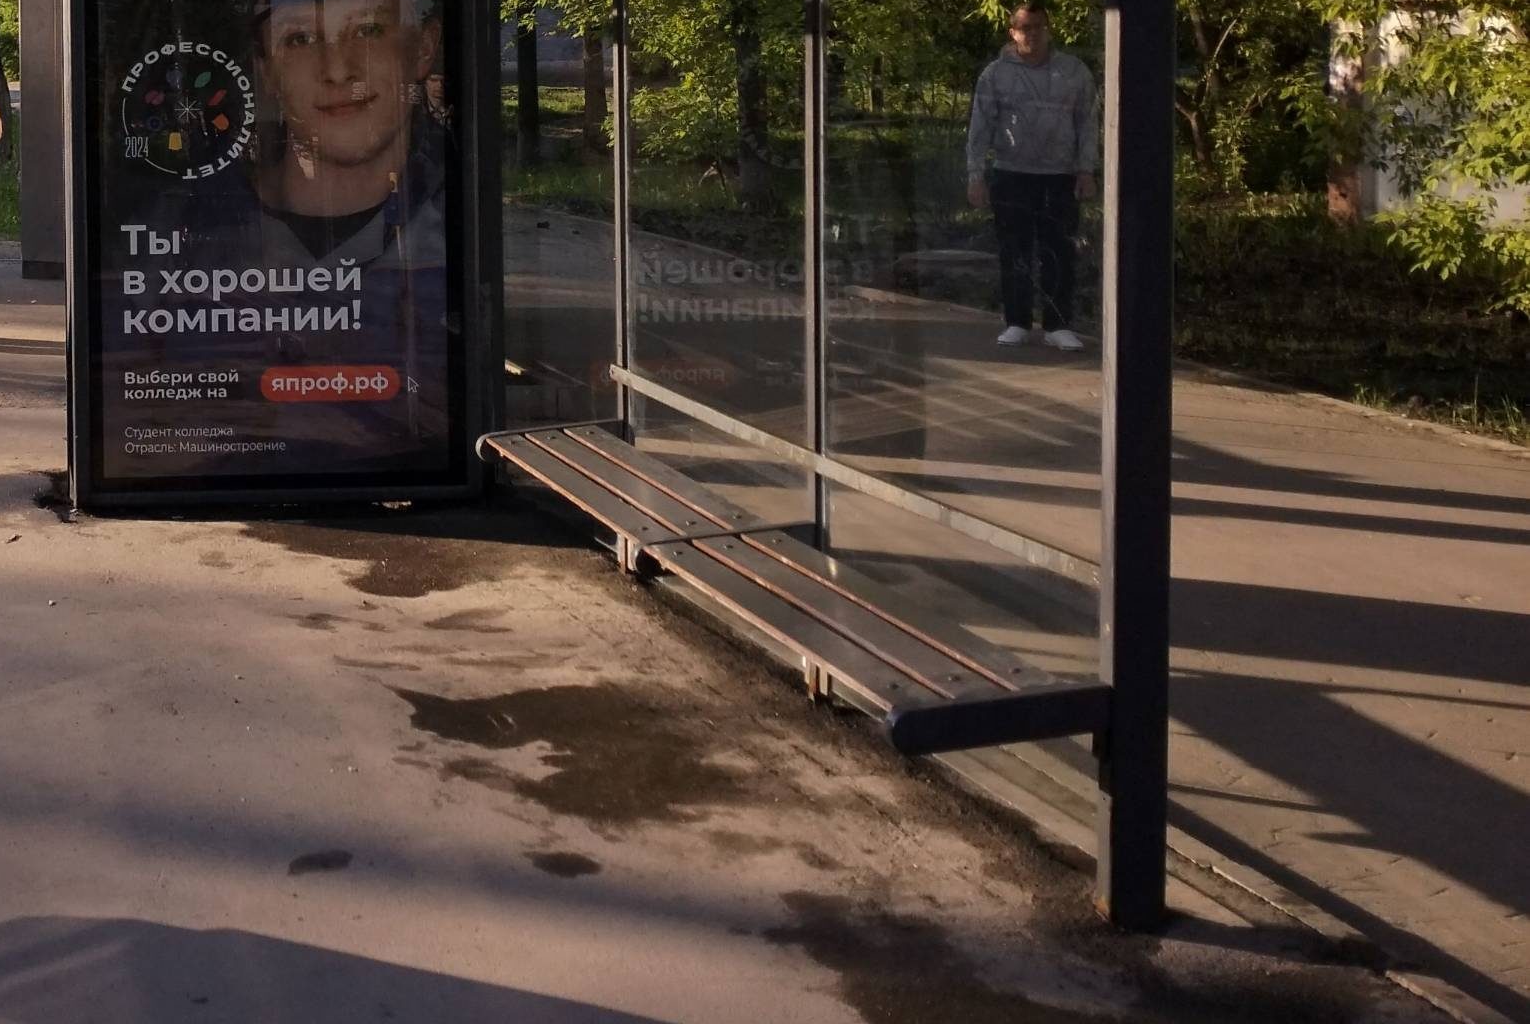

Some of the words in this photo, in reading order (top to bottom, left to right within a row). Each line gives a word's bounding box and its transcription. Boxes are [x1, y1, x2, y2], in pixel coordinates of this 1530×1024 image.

[121, 41, 255, 180] ПРОФЕССИОНАЛИТЕТ
[125, 136, 149, 158] 2024
[120, 224, 180, 255] Ты
[123, 270, 146, 295] в
[159, 258, 361, 301] хорошей
[123, 299, 361, 334] компании!
[124, 370, 193, 387] Выбери
[198, 369, 239, 384] свой
[271, 372, 389, 395] япроф.рф
[124, 387, 202, 401] колледж
[207, 387, 227, 398] на
[125, 426, 172, 439] Студент
[175, 427, 233, 439] колледжа
[125, 442, 177, 454] Отрасль:
[179, 441, 286, 454] Машиностроение
